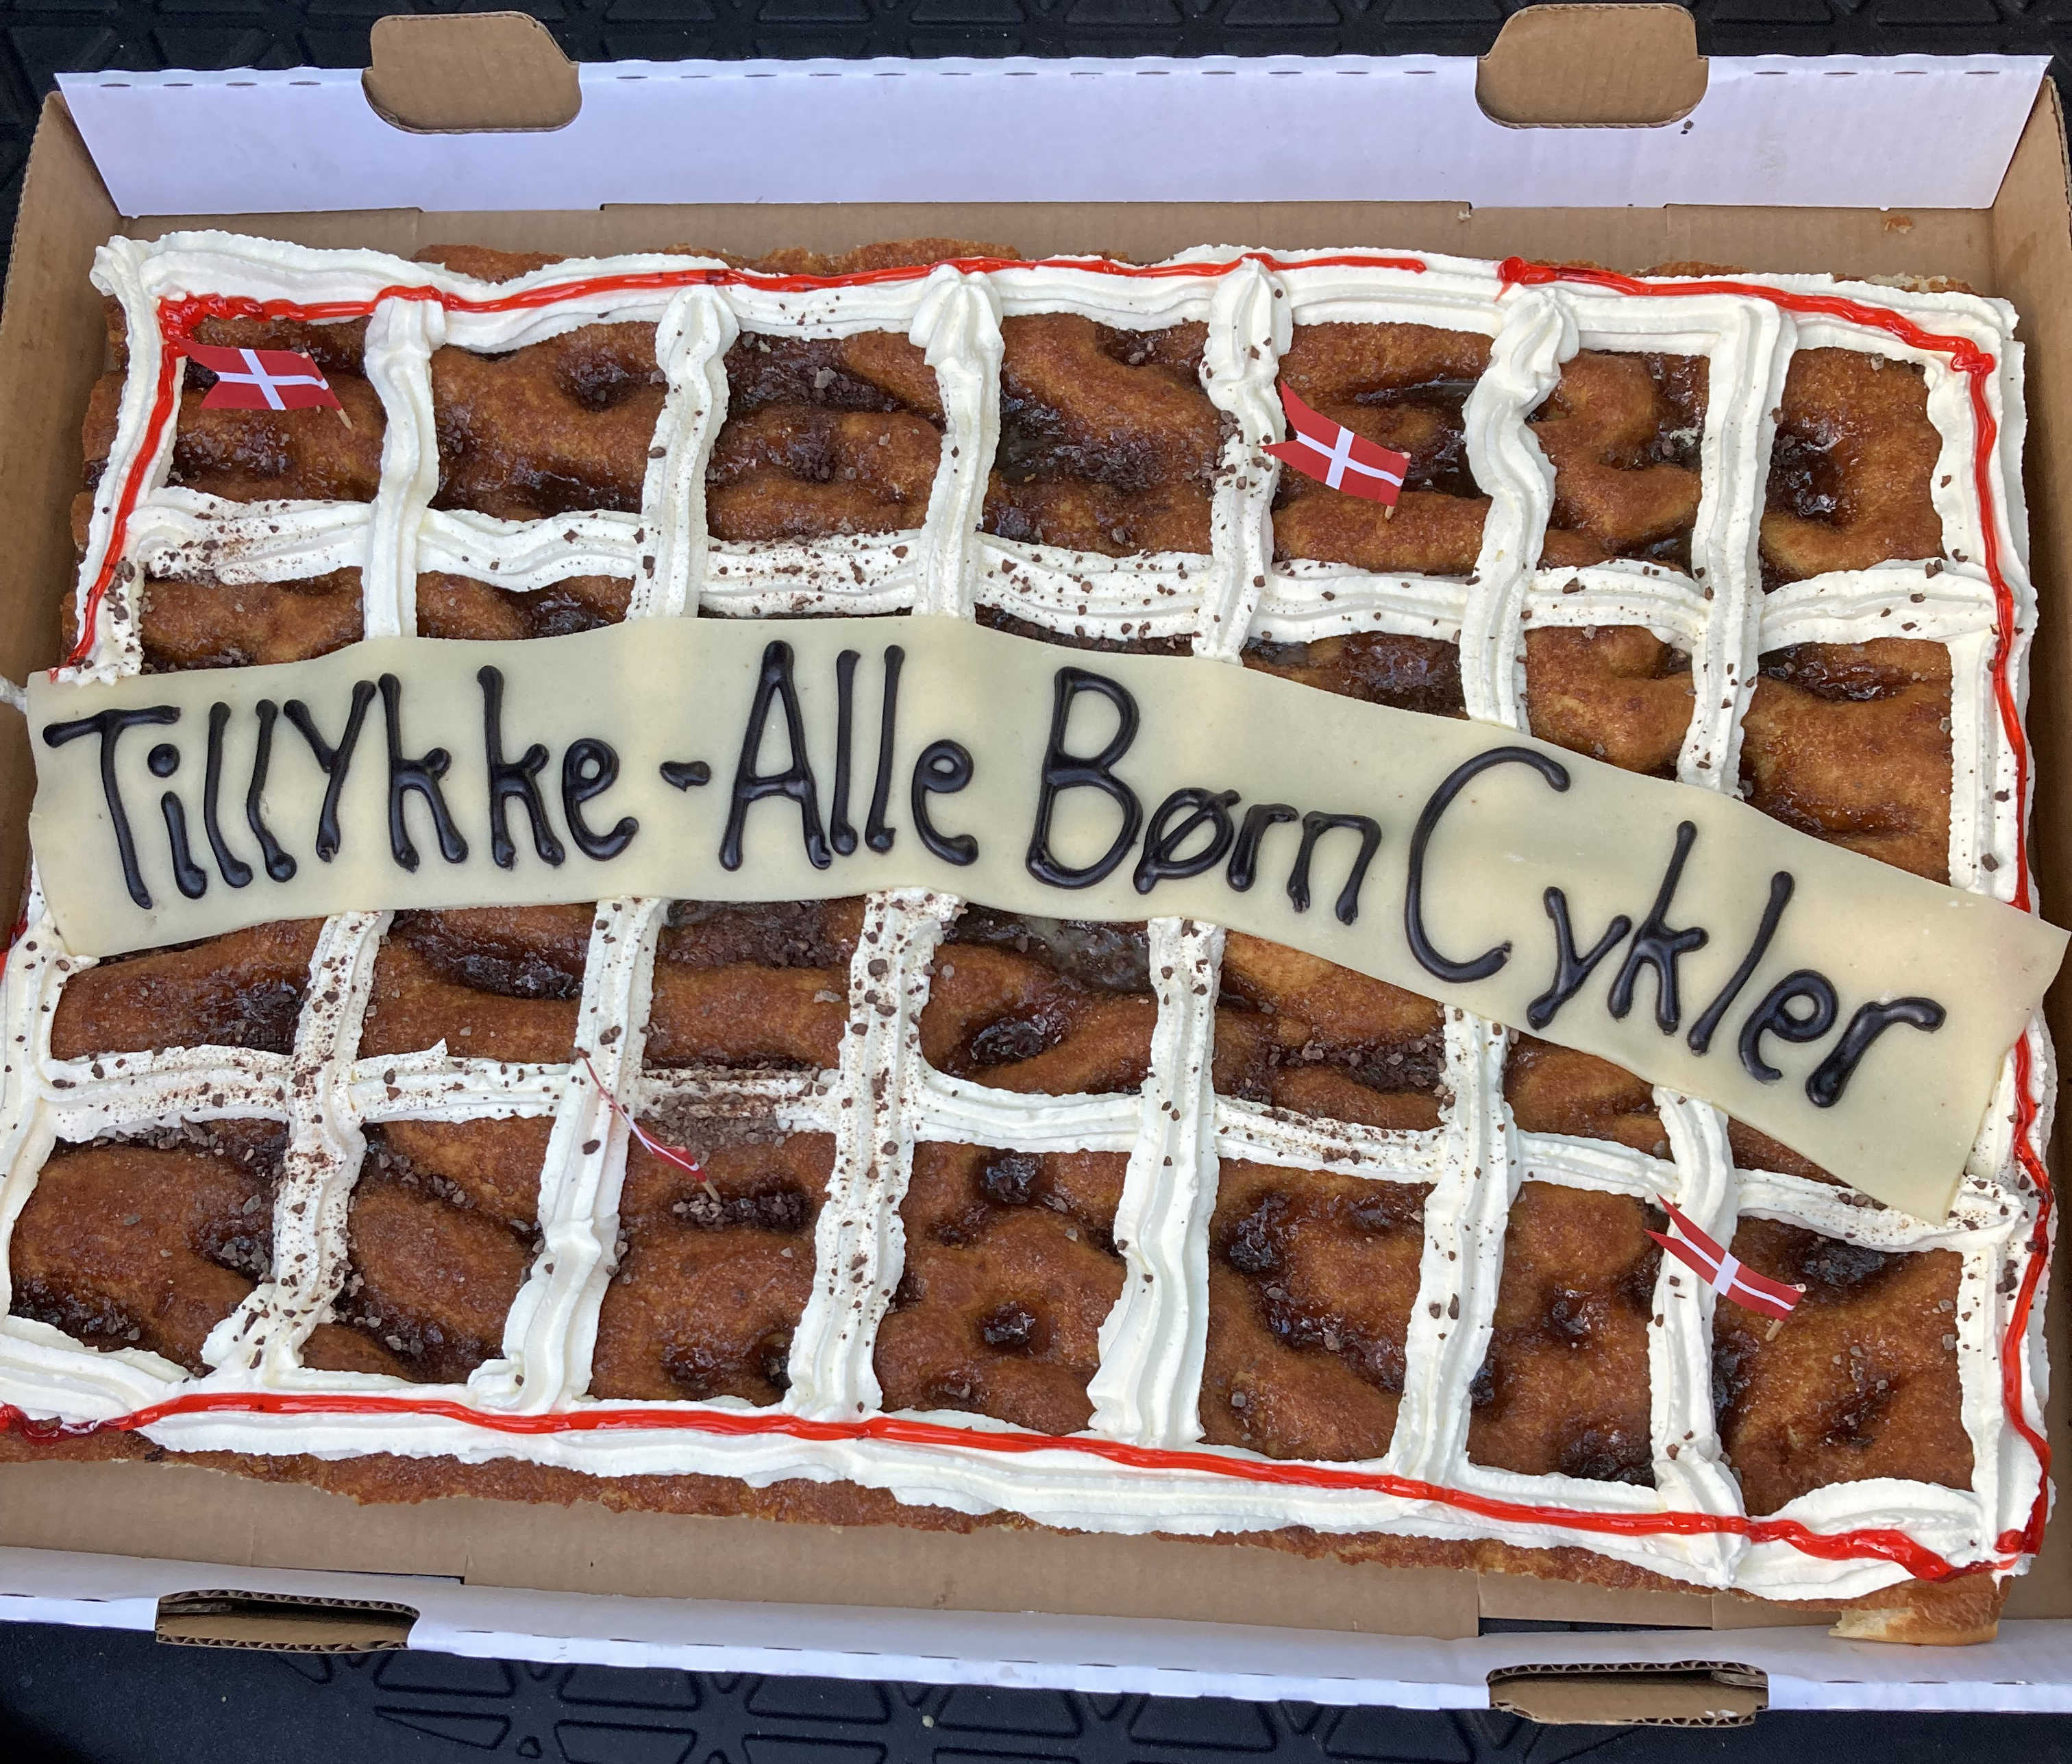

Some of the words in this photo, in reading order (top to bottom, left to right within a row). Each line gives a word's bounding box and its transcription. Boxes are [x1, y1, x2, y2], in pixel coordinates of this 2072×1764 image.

[718, 639, 980, 873] Alle
[1024, 665, 1383, 927] Børn
[1403, 745, 1947, 1110] Cykler
